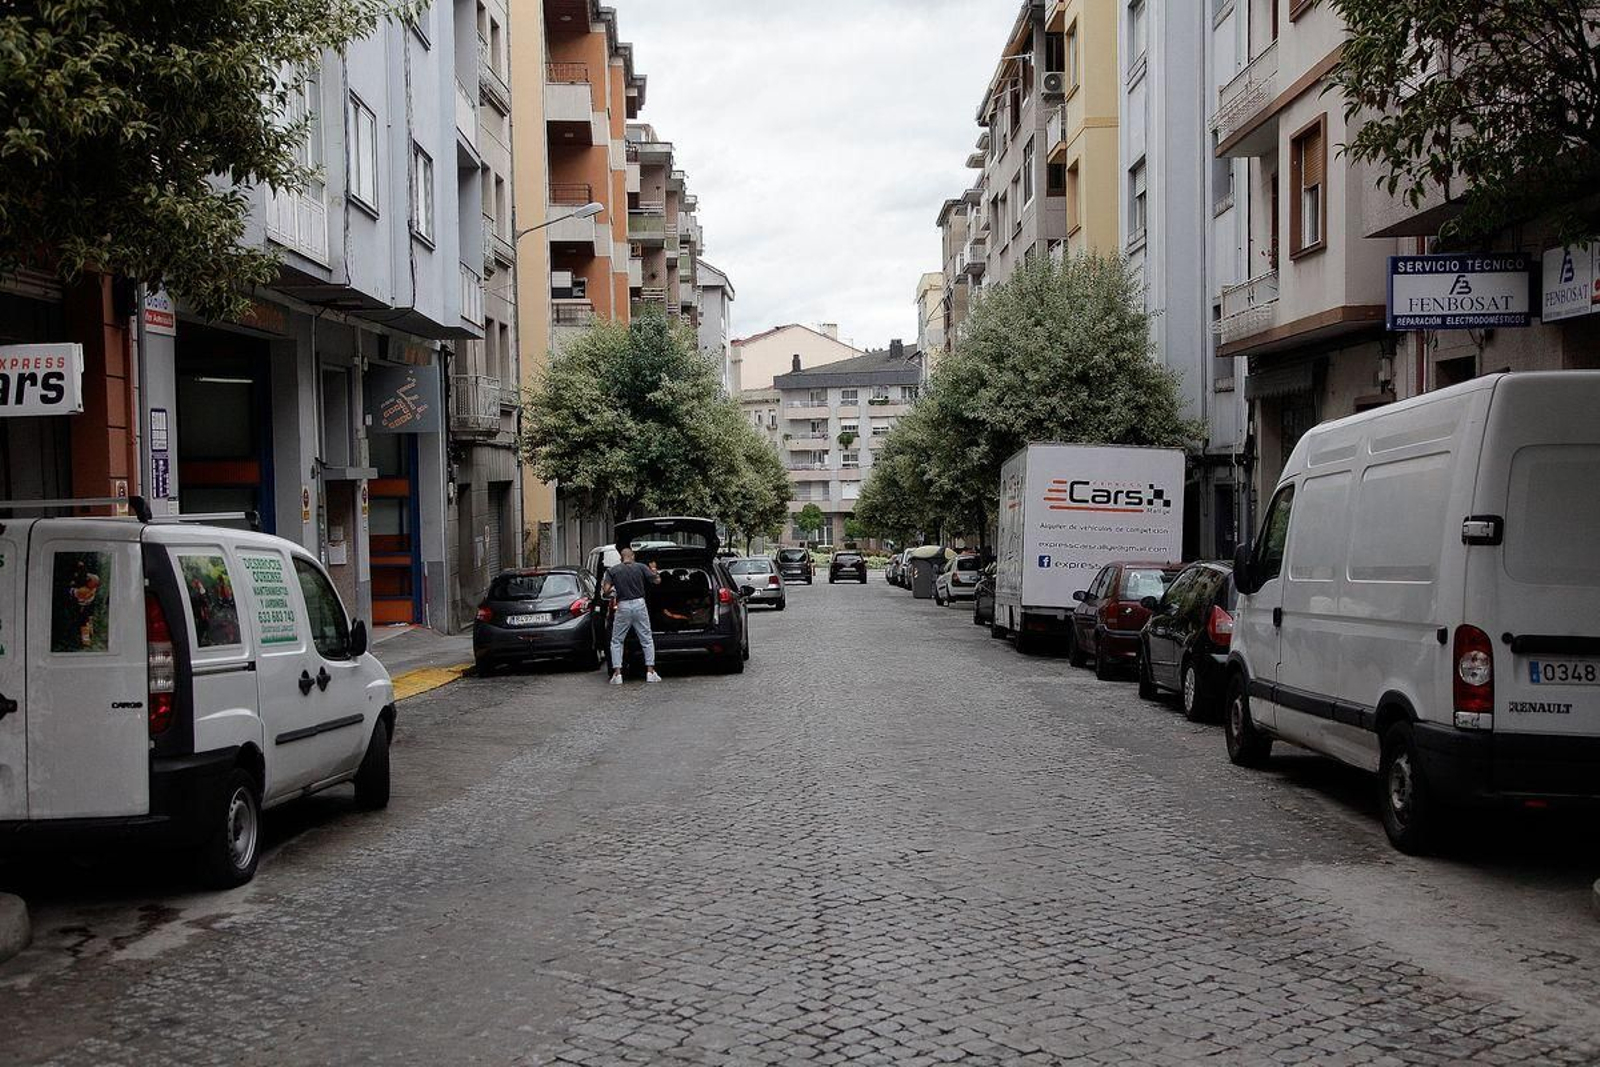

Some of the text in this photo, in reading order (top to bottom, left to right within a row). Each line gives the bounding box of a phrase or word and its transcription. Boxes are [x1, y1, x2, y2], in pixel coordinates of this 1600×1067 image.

[1398, 260, 1460, 273] SERVICIO
[1545, 284, 1588, 307] FENBOSAT
[1409, 295, 1514, 312] FENBOSAT
[1396, 315, 1525, 326] REPARACIÓN ELECTRODOMÉSTICOS
[1068, 480, 1143, 506] Cars
[1068, 523, 1078, 531] de
[258, 611, 271, 624] 633
[1543, 663, 1596, 682] 0348
[1508, 701, 1573, 714] RENAULT
